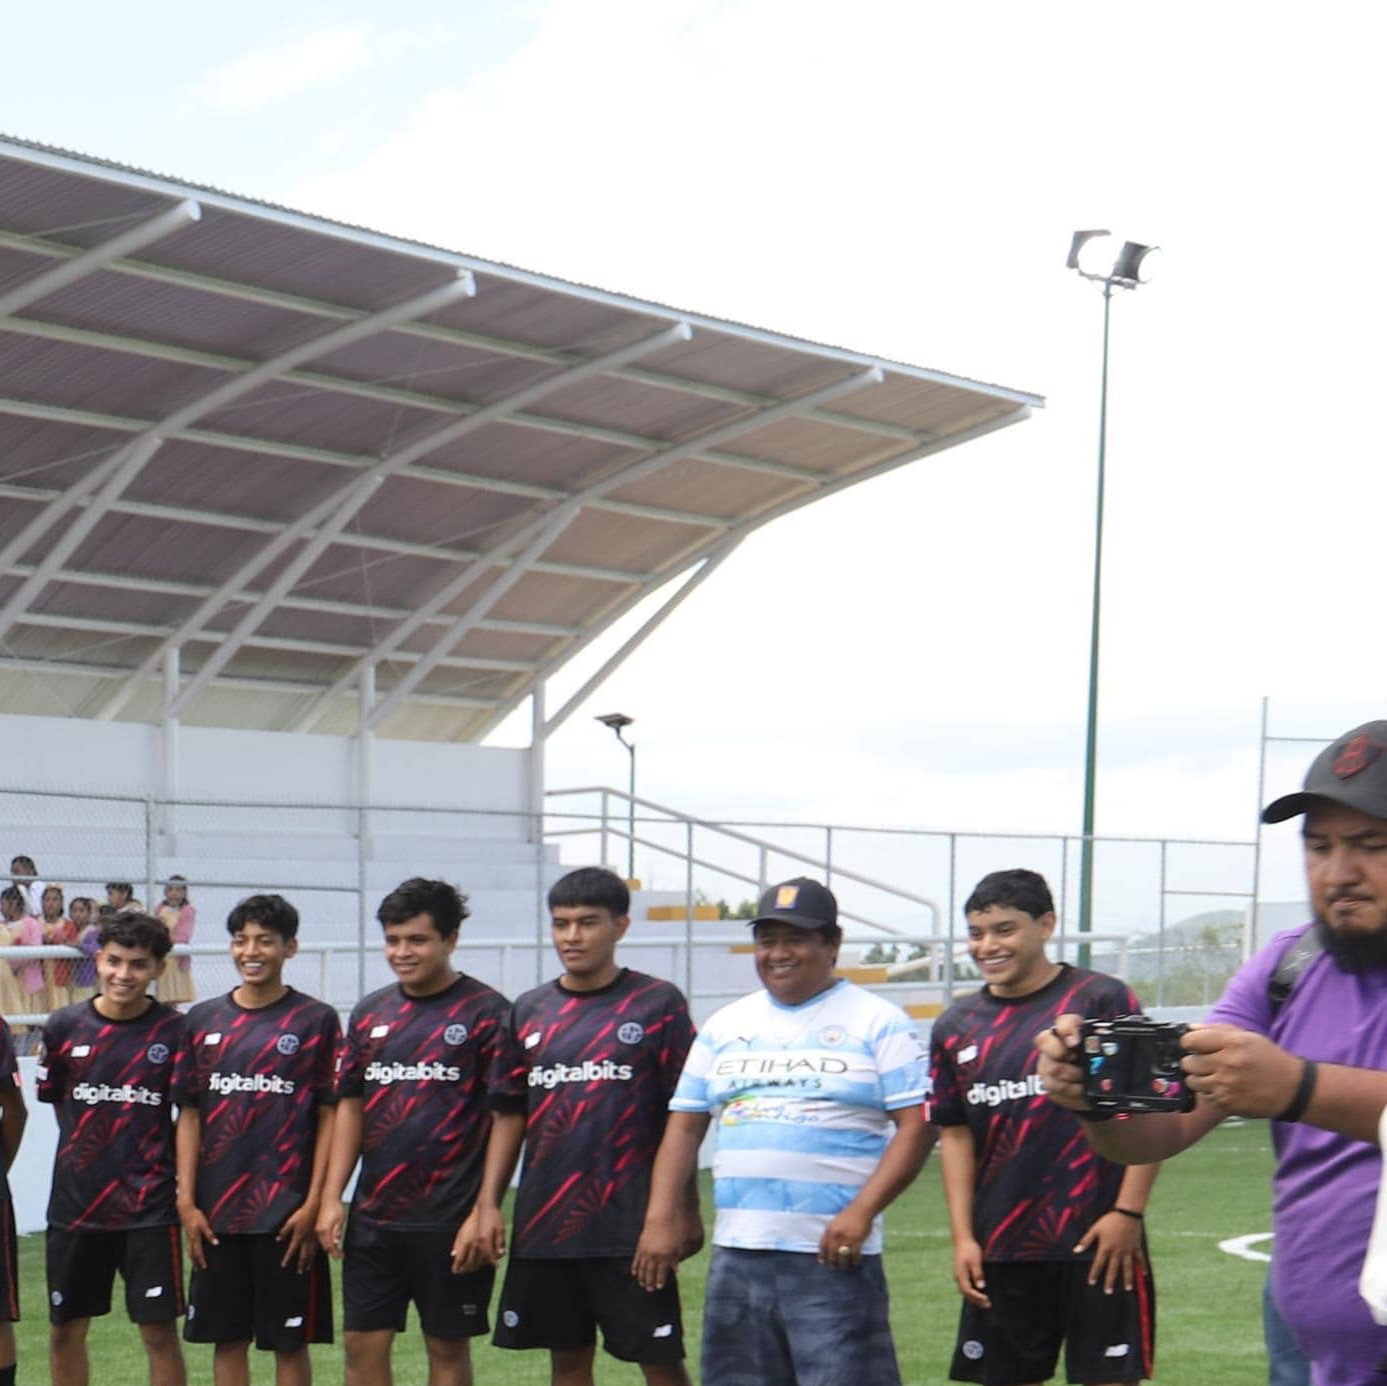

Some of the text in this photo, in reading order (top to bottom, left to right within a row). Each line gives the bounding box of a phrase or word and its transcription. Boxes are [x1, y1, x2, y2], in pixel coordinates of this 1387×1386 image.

[528, 1060, 633, 1089] digitalbits
[717, 1057, 848, 1076] ETIHAD
[73, 1083, 163, 1105] digitalbits
[729, 1078, 823, 1090] AIRWAYS
